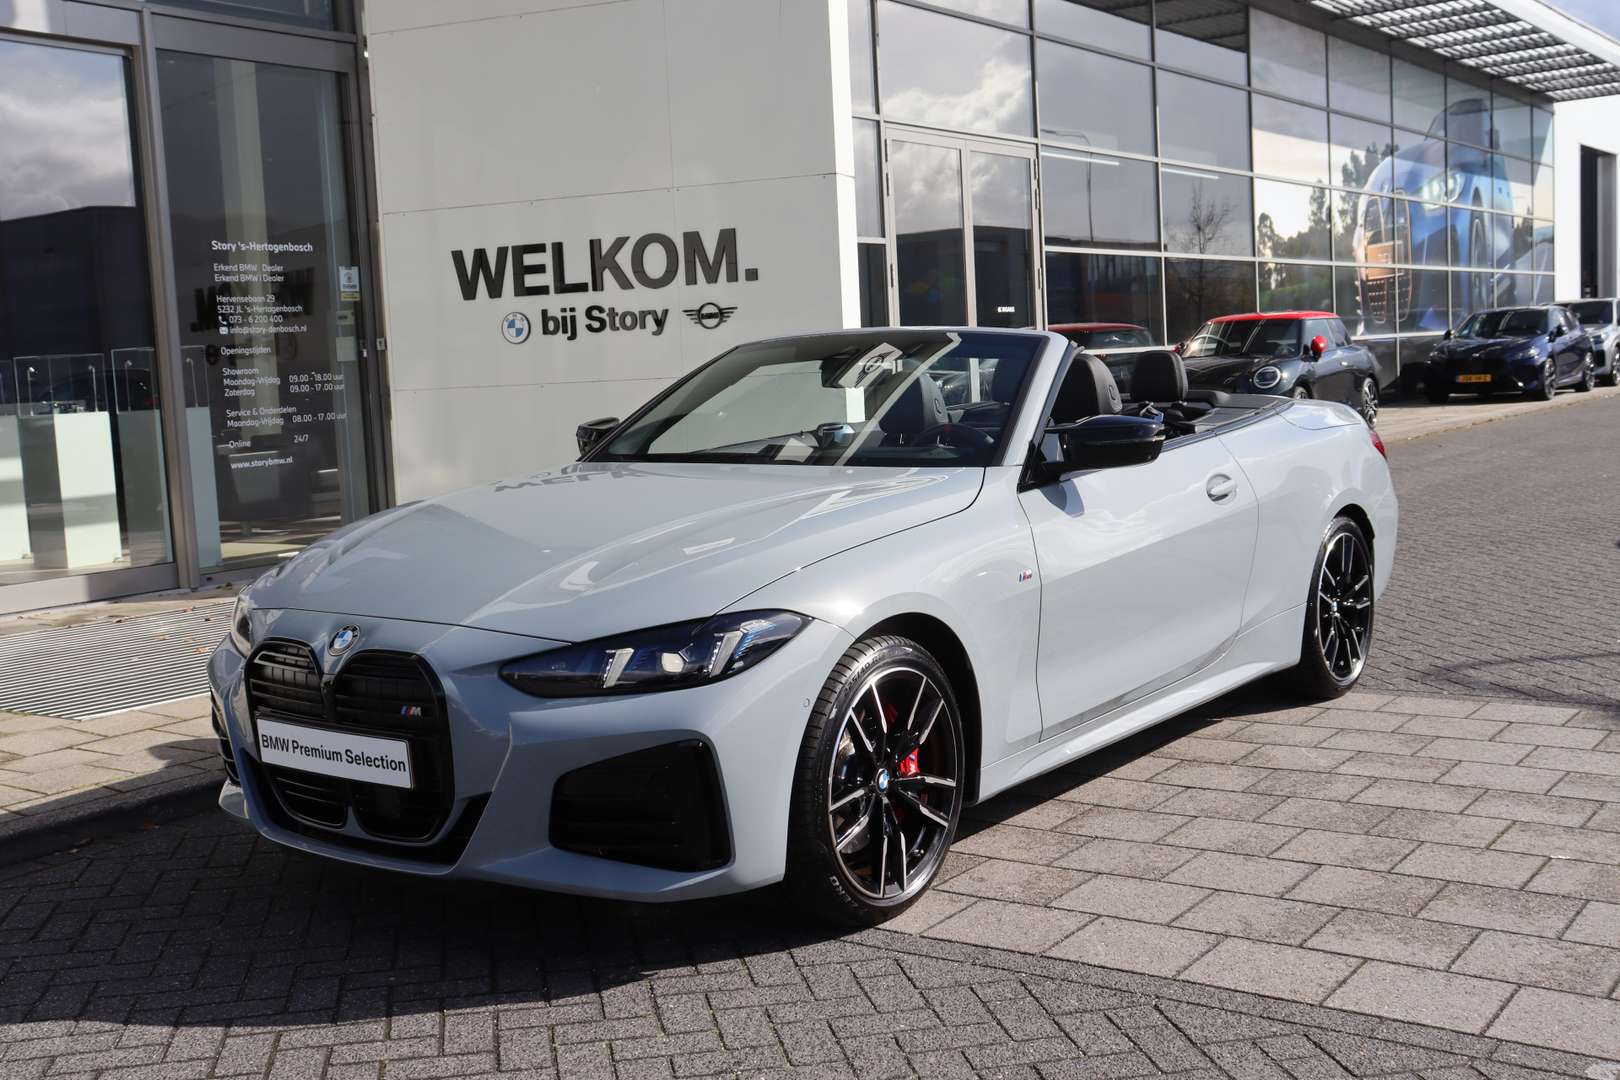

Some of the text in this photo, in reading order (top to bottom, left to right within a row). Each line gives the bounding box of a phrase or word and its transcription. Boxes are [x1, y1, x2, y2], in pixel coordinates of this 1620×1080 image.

[211, 240, 313, 253] Story 's-Hertogenbosch
[213, 263, 284, 272] Erkend BMW Dealer
[451, 228, 758, 300] WELKOM.
[214, 274, 239, 282] Erkend
[240, 274, 258, 282] BMW
[263, 274, 284, 282] Dealer
[266, 294, 275, 303] 29
[217, 305, 234, 313] 5232
[236, 305, 243, 314] JL
[229, 315, 242, 323] 073
[249, 315, 253, 323] 6
[254, 315, 268, 323] 200
[269, 315, 283, 323] 400
[541, 304, 669, 340] bij Story
[222, 368, 259, 376] Showroom
[289, 374, 309, 383] 09.00
[224, 388, 256, 397] Zaterdag
[289, 384, 310, 393] 09.00
[226, 406, 297, 417] Service & Onderdelen
[292, 414, 312, 423] 08.00
[228, 434, 309, 448] Online 24/7
[261, 734, 406, 772] BMW Premium Selection
